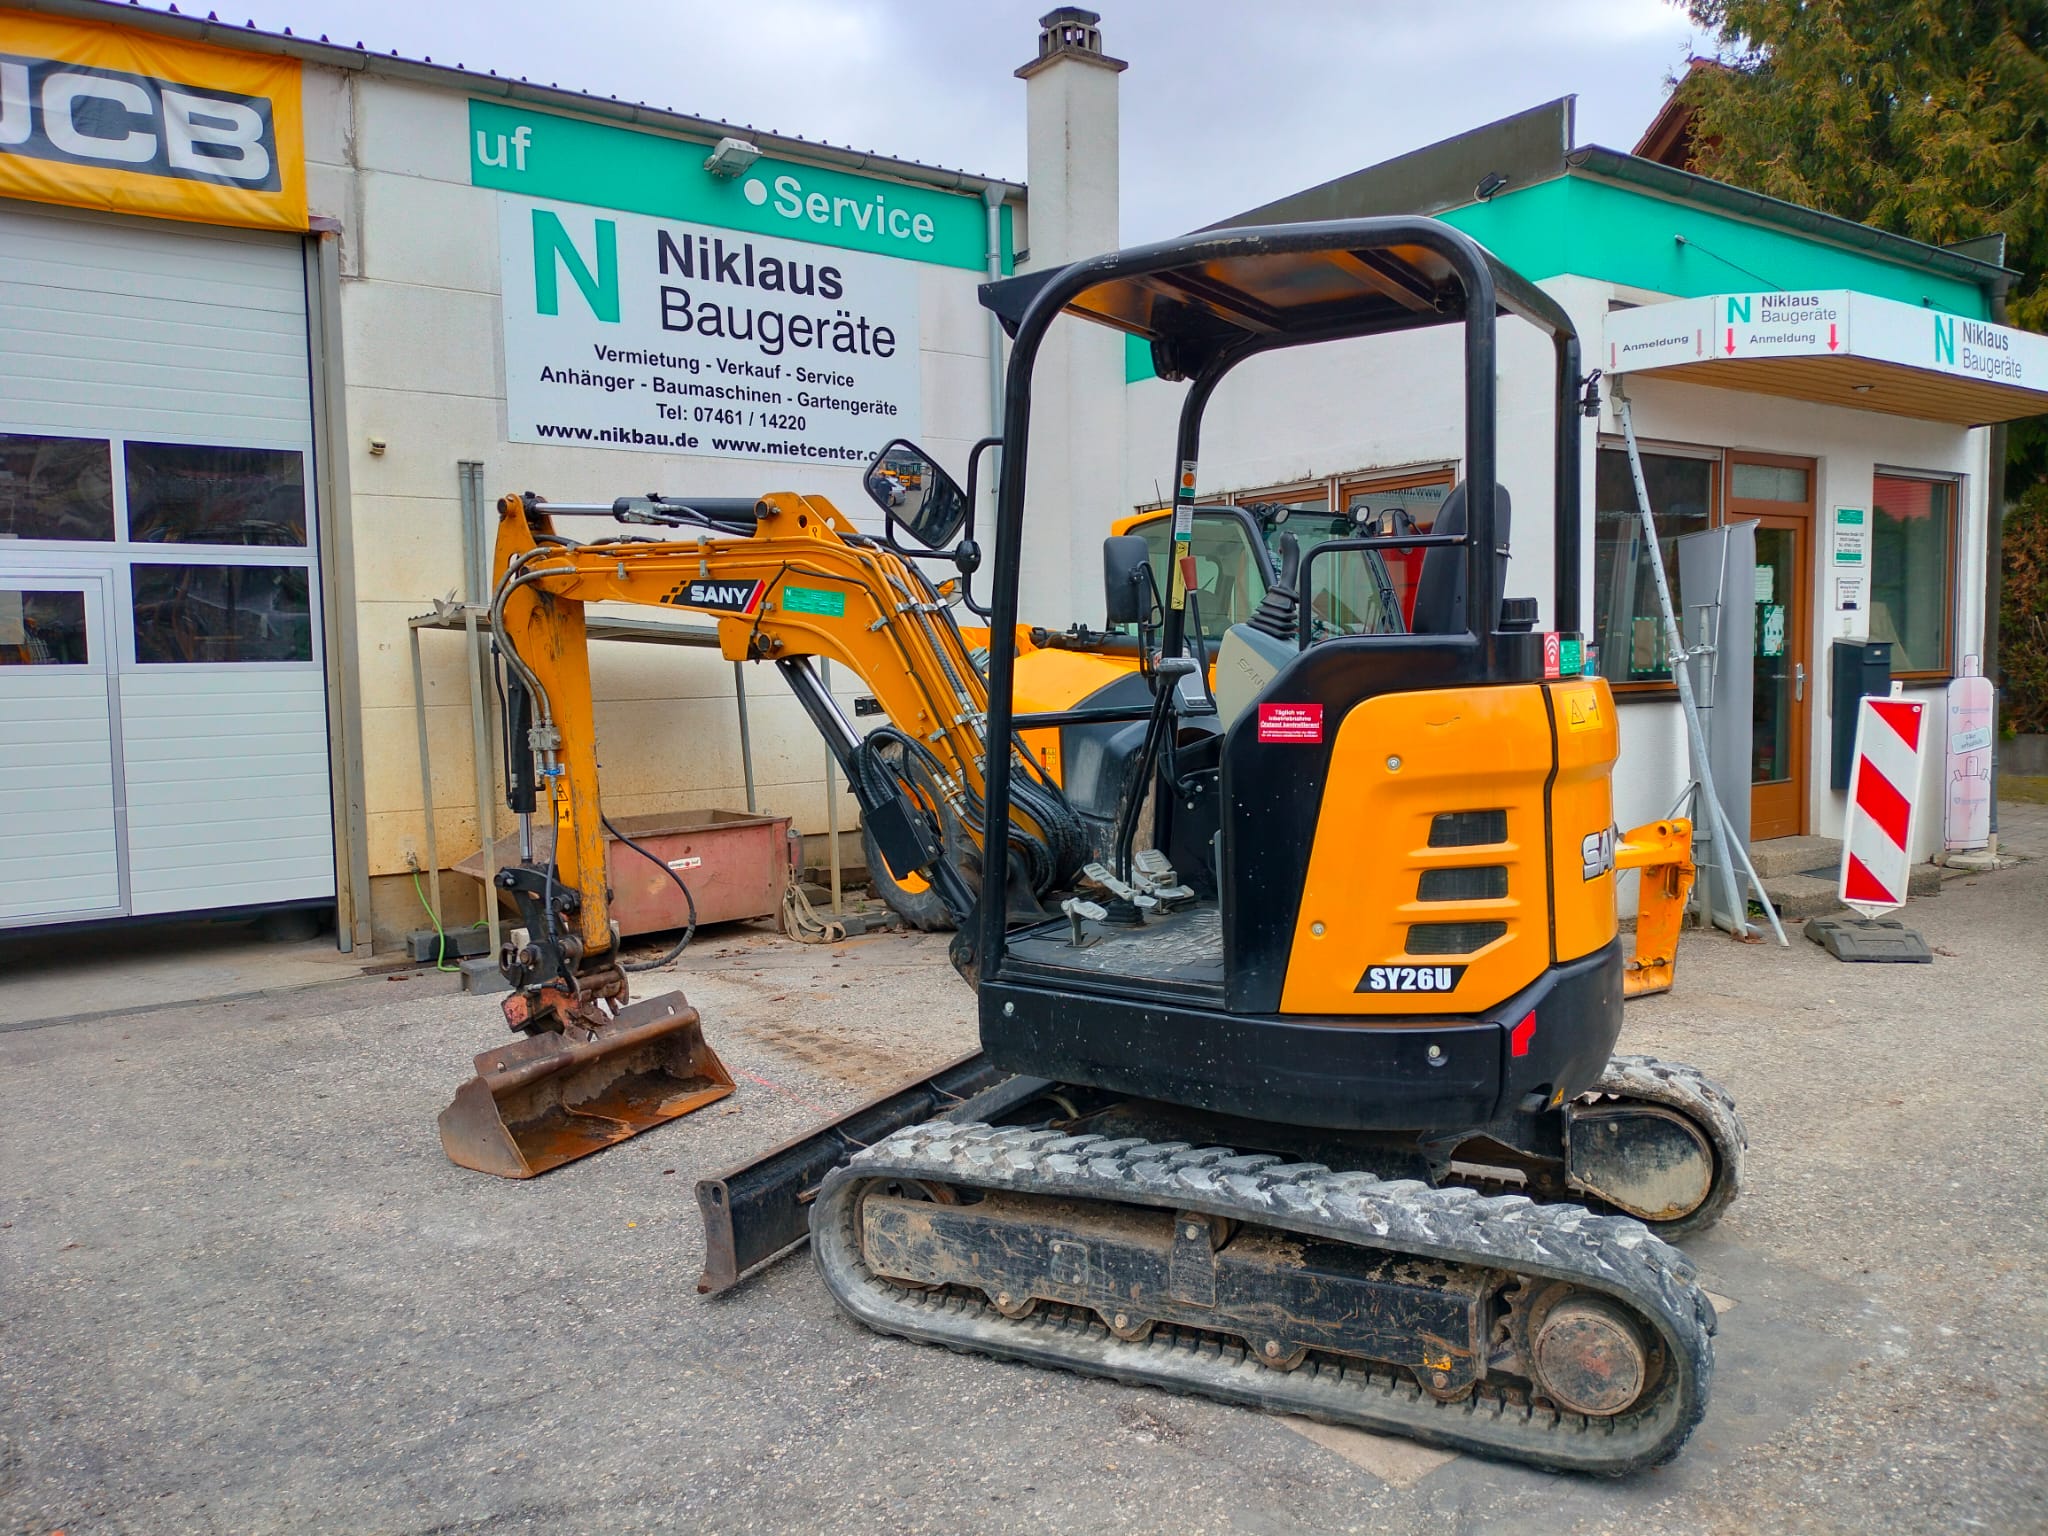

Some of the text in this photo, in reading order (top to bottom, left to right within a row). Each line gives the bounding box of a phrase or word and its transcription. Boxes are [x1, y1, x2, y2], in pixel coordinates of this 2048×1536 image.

[0, 61, 270, 180] JCB
[476, 126, 532, 171] uf
[772, 175, 935, 244] Service
[531, 208, 621, 324] N
[657, 229, 843, 300] Niklaus
[1727, 297, 1751, 323] N
[1761, 295, 1819, 308] Niklaus
[1761, 308, 1837, 325] Baugeräte
[660, 285, 896, 358] Baugeräte
[1750, 333, 1816, 345] Anmeldung
[1935, 315, 1954, 365] N
[1963, 321, 2009, 351] Niklaus
[1622, 335, 1689, 353] Anmeldung
[594, 344, 700, 374] Vermietung
[717, 358, 781, 380] Verkauf
[796, 367, 855, 388] Service
[1963, 348, 2022, 379] Baugeräte
[540, 366, 635, 393] Anhänger
[653, 376, 781, 404] Baumaschinen
[797, 392, 898, 416] Gartengeräte
[656, 403, 688, 421] Tel:
[694, 406, 744, 426] 07461
[760, 413, 806, 431] 14220
[536, 424, 878, 462] www.nikbau.de www.mietcenter.c
[690, 585, 749, 605] SANY
[1582, 828, 1614, 882] SA
[1369, 967, 1452, 990] SY26U
